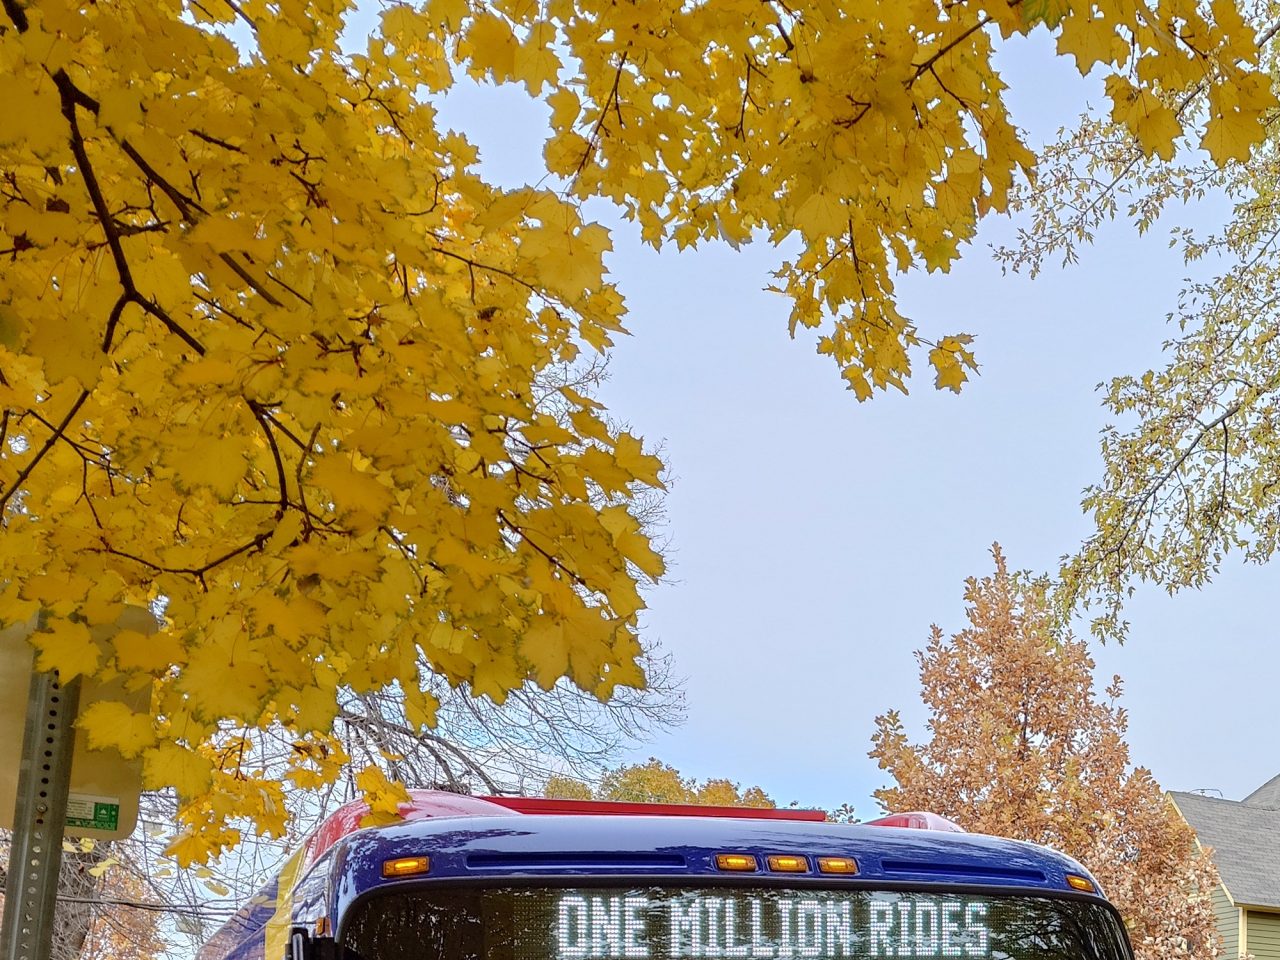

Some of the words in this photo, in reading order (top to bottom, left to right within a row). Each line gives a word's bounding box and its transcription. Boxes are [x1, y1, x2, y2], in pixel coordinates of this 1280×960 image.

[557, 895, 649, 957] ONE
[670, 897, 851, 957] MILLION
[869, 900, 990, 957] RIDES
